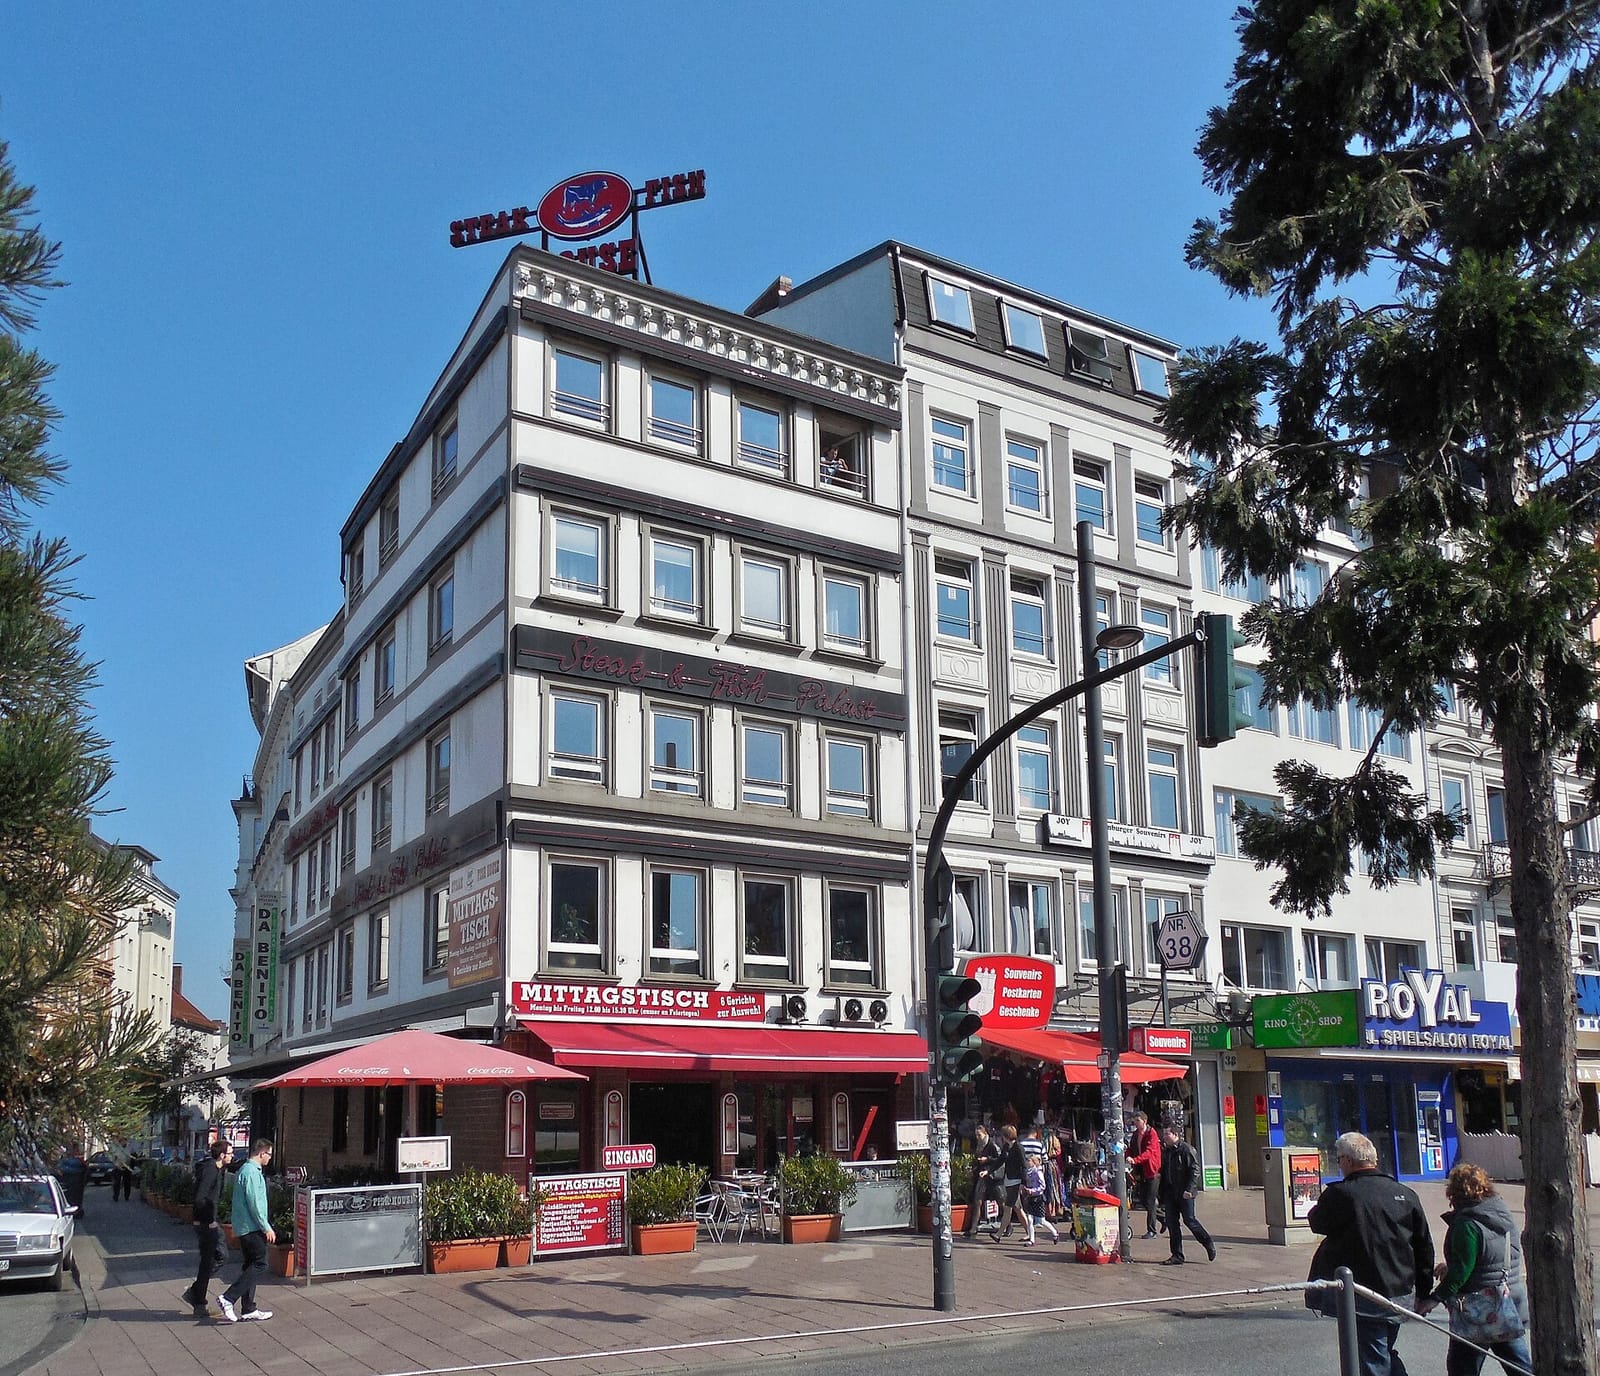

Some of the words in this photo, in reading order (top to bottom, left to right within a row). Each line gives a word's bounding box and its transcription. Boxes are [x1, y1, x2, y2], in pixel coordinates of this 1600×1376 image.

[645, 170, 706, 207] FISH
[450, 207, 529, 245] STEAK
[559, 635, 647, 684] Steak
[667, 662, 686, 690] &
[708, 663, 768, 705] Fish
[794, 679, 876, 721] Palast
[1055, 817, 1071, 826] JOY
[1135, 828, 1167, 839] Souvenirs
[1189, 837, 1203, 845] JOY
[258, 909, 271, 932] DA
[1167, 919, 1187, 932] NR.
[460, 914, 490, 944] TISCH
[1165, 936, 1192, 960] 38
[234, 953, 245, 972] DA
[254, 942, 270, 1020] BENITO
[1003, 967, 1043, 981] Souvenirs
[520, 983, 709, 1009] MITTAGSTISCH
[726, 994, 756, 1006] Gerichte
[1002, 987, 1042, 1000] Postkarten
[1363, 967, 1480, 1027] ROYAL
[231, 979, 244, 1042] BENITO
[563, 1004, 585, 1015] Freitag
[628, 1006, 639, 1014] Uhr
[717, 1009, 729, 1018] zur
[998, 1005, 1040, 1019] Geschenke
[1264, 1018, 1288, 1029] KINO
[1318, 1015, 1343, 1027] SHOP
[1190, 1024, 1219, 1035] KINO
[1148, 1035, 1187, 1050] Souvenirs
[1383, 1030, 1467, 1048] SPIELSALON
[1472, 1034, 1514, 1050] ROYAL
[1224, 1055, 1237, 1066] 38
[337, 1066, 390, 1076] Coca-Cola
[466, 1066, 515, 1075] Coca-Cola
[604, 1148, 654, 1166] EINGANG
[539, 1177, 621, 1191] MITTAGSTISCH
[319, 1199, 344, 1210] STEAK
